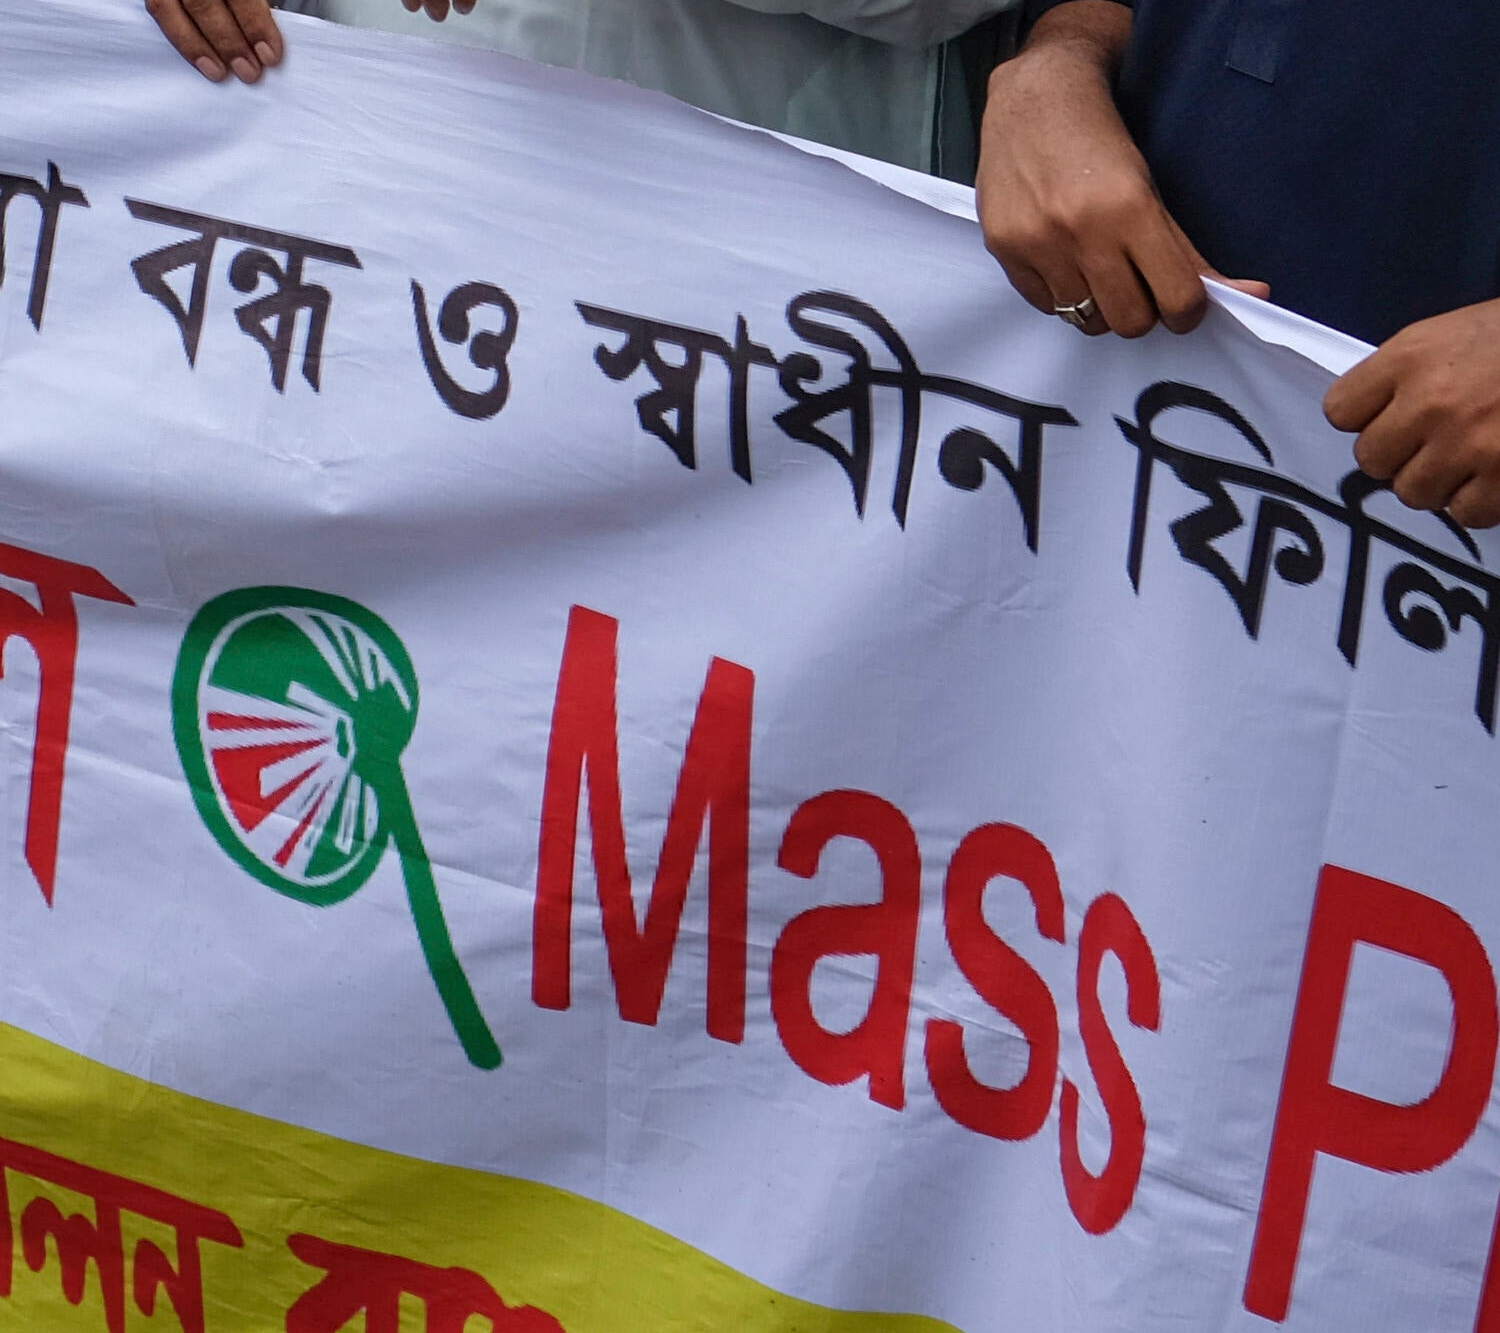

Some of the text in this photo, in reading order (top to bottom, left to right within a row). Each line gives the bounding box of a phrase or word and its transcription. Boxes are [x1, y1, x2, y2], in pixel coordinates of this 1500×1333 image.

[125, 197, 362, 393] বন্ধ
[409, 278, 518, 420] ও
[576, 288, 1078, 554] স্বাধীন
[531, 604, 1162, 1235] Mass
